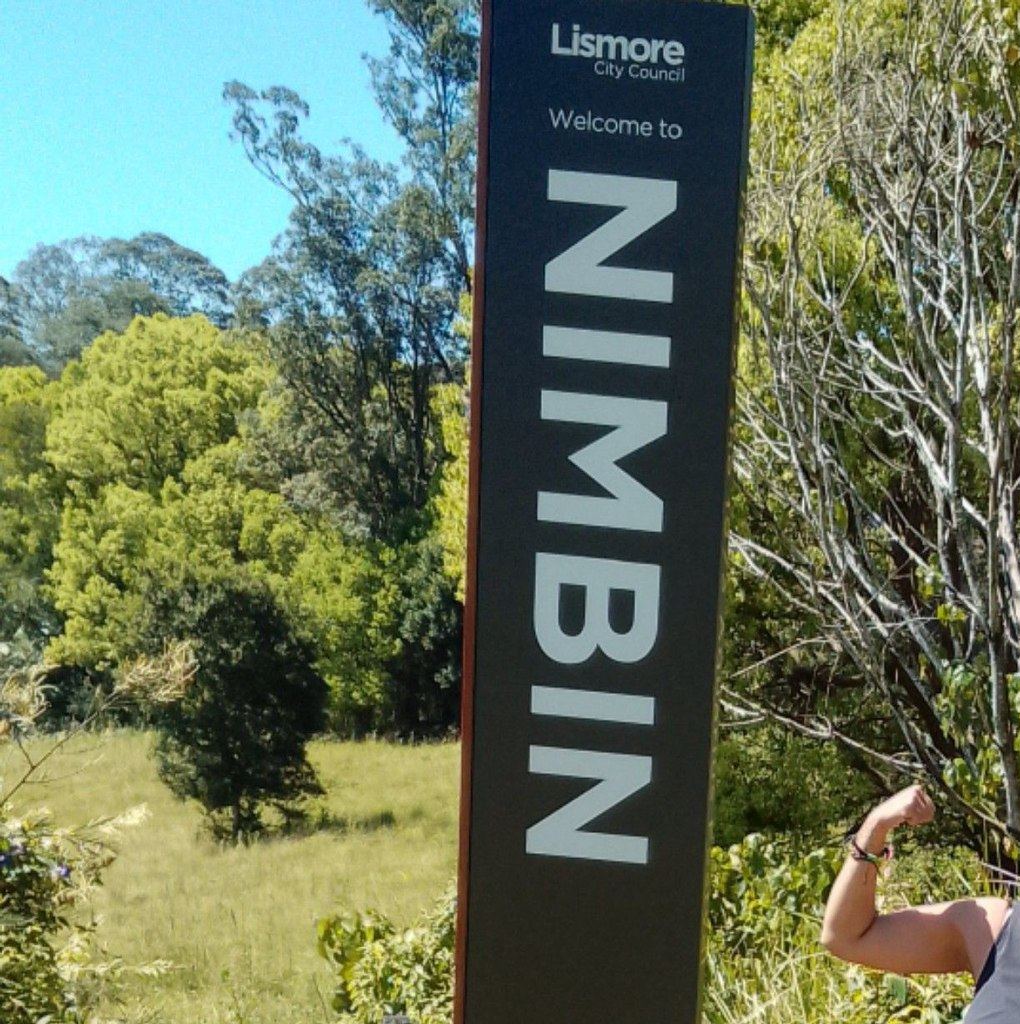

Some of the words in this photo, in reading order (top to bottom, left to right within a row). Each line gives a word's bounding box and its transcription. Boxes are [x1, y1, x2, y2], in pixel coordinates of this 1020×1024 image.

[551, 23, 685, 65] Lismore
[593, 61, 624, 79] City
[628, 64, 686, 82] Council
[549, 108, 653, 136] Welcome
[659, 120, 683, 139] to
[526, 169, 678, 864] NIMBIN
